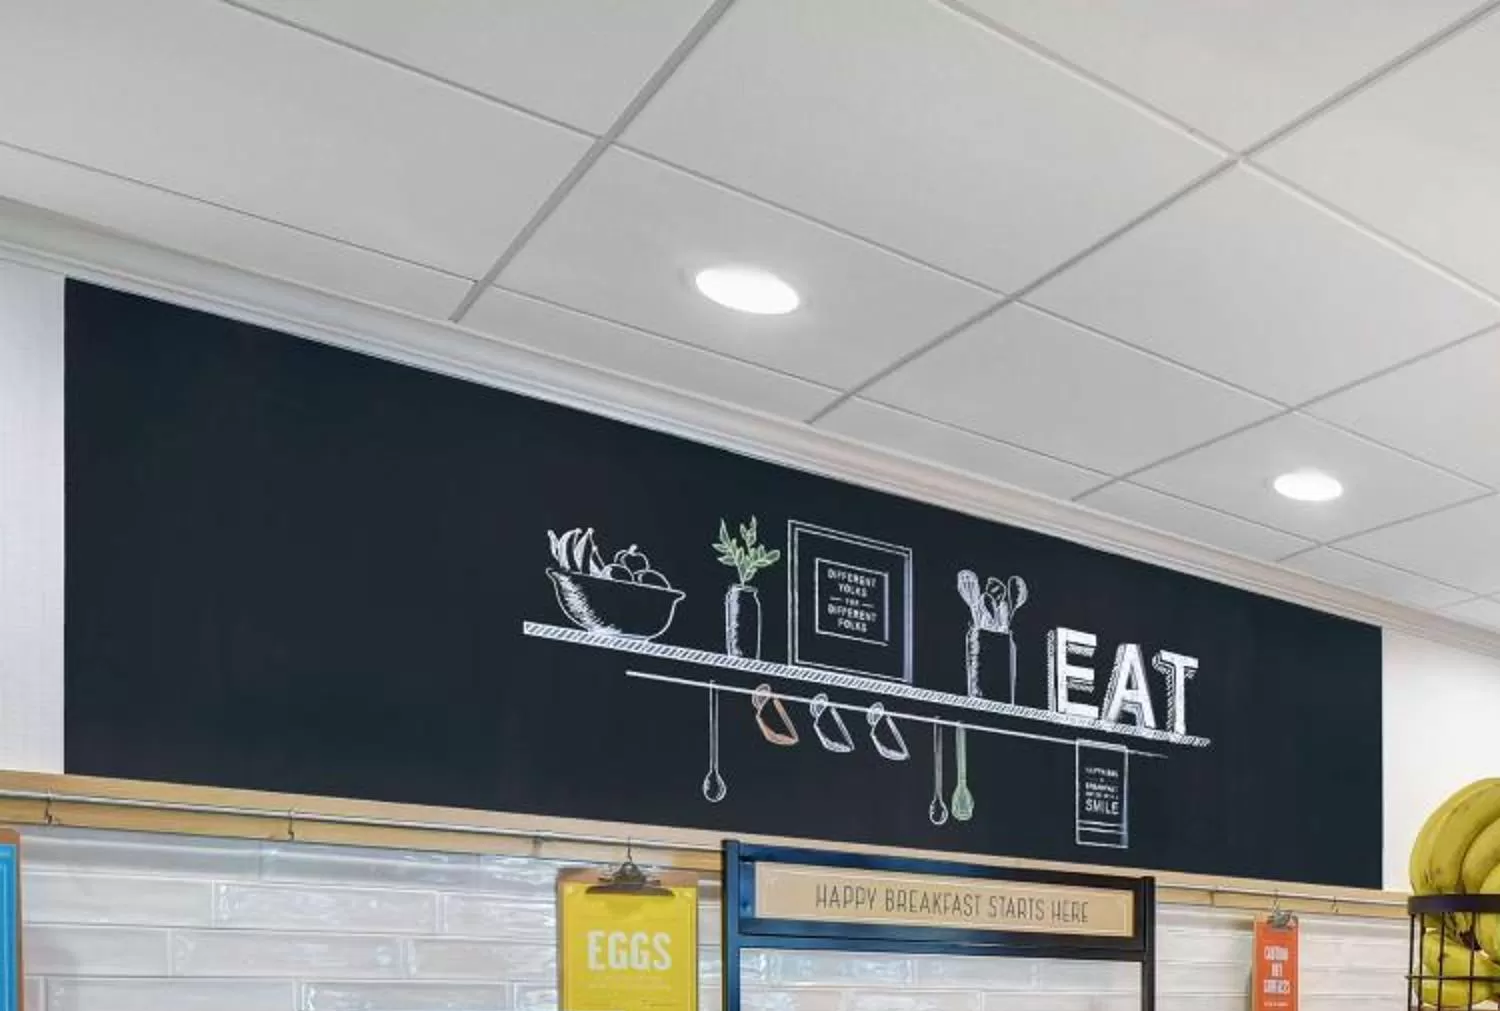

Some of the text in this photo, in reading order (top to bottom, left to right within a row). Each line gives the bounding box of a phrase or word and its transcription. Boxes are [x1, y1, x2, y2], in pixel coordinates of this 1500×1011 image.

[827, 568, 877, 587] DIFFERENT
[827, 603, 878, 622] DIFFERENT
[1048, 627, 1199, 735] EAT
[1084, 798, 1120, 815] SMILE
[816, 884, 1089, 923] HAPPY BREAKFAST STARTS HERE
[587, 930, 672, 971] EGGS
